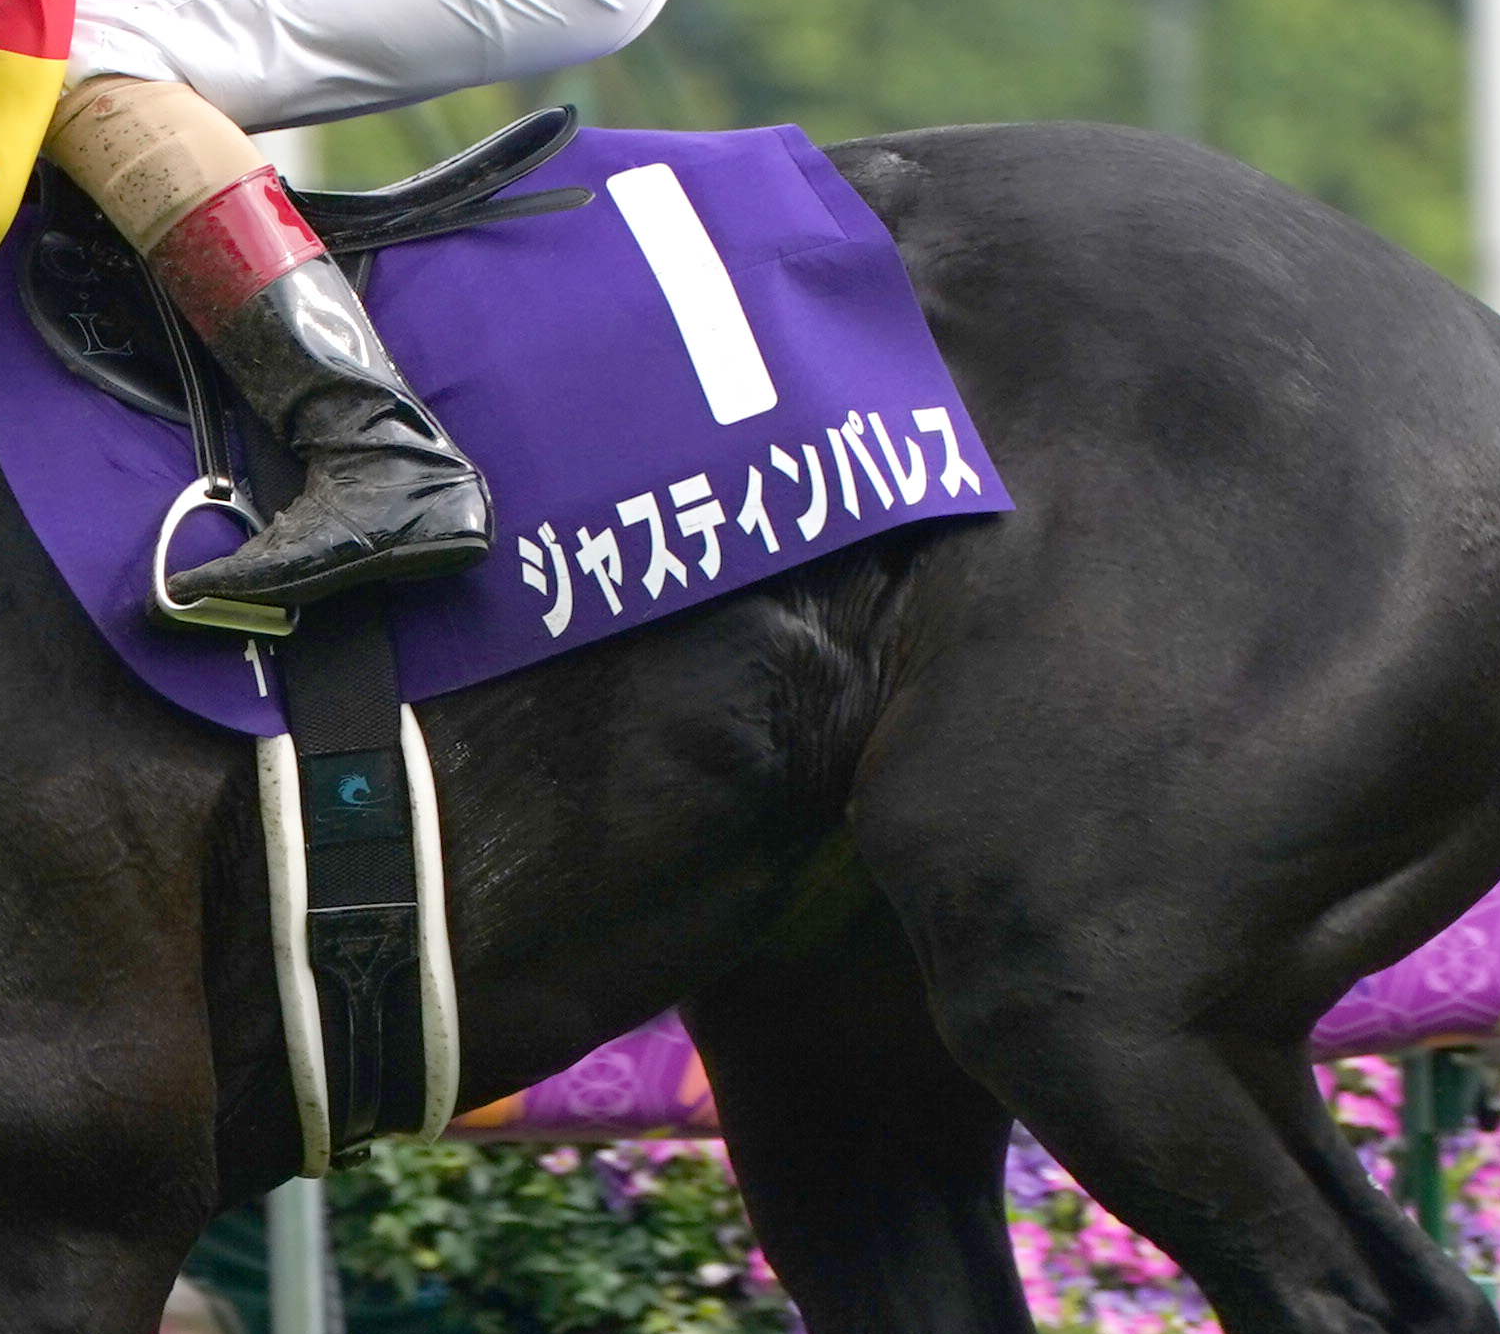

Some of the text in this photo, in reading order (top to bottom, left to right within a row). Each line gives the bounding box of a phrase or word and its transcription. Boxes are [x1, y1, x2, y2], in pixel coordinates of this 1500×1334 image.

[606, 162, 778, 426] 1
[518, 406, 982, 639] ジャスティンパレス
